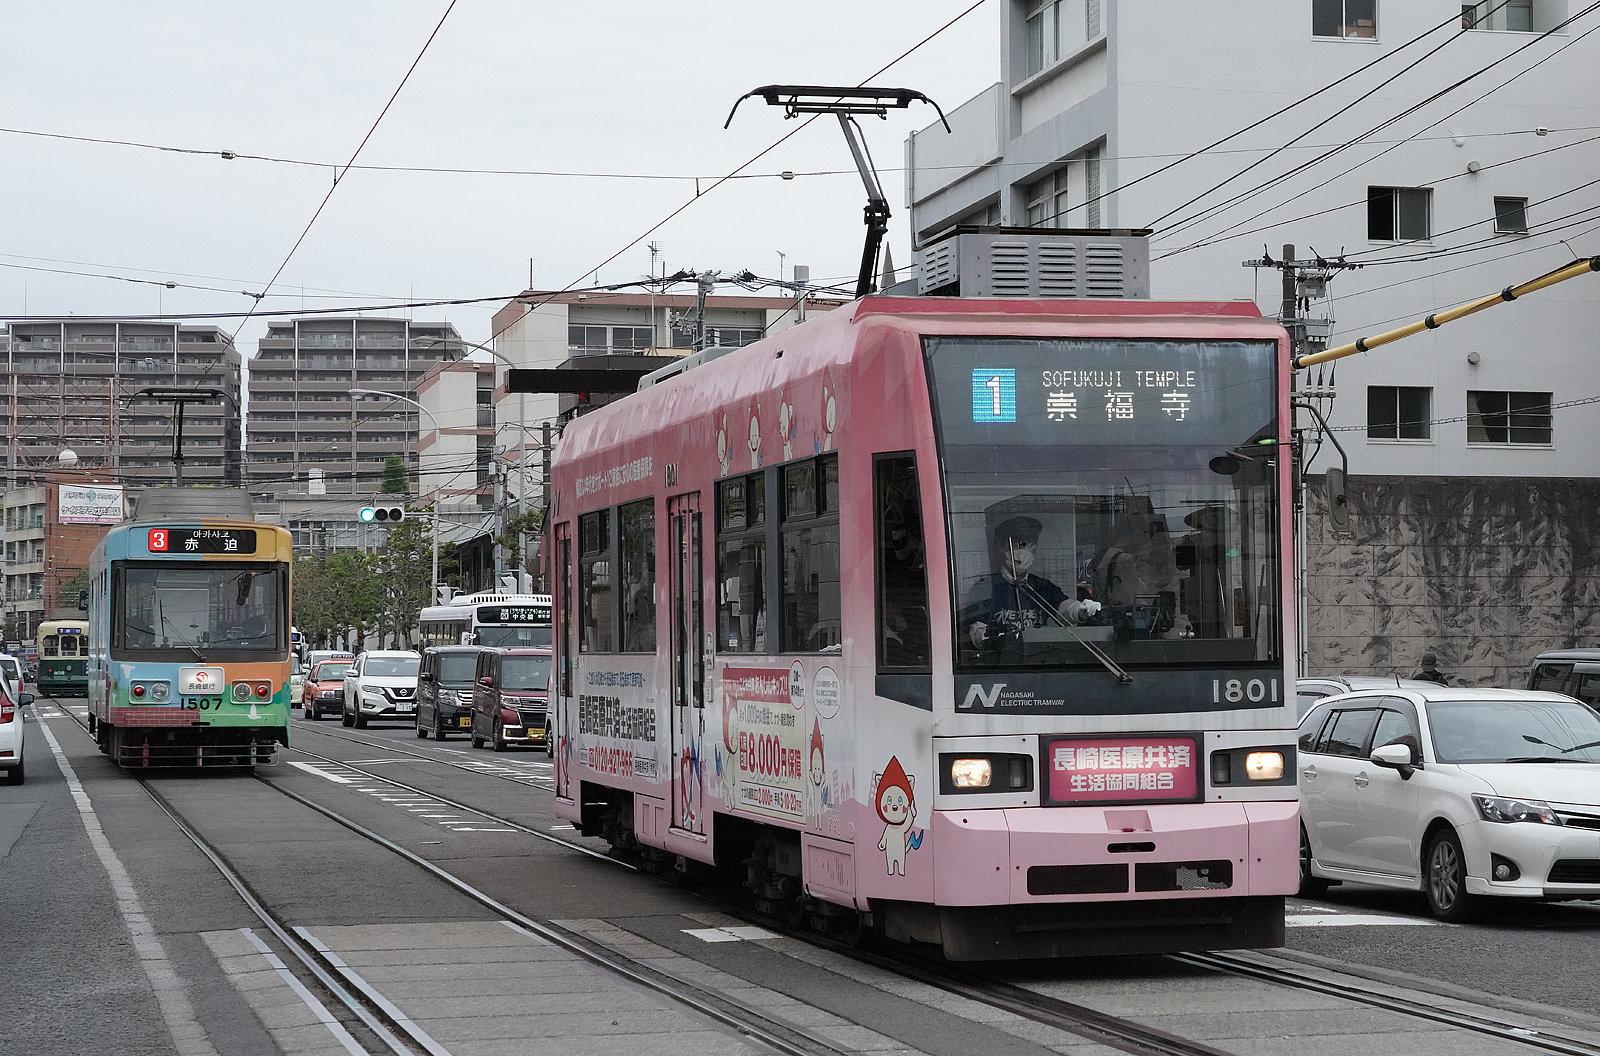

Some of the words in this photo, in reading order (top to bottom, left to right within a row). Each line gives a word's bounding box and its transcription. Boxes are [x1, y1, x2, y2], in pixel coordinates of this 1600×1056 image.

[1042, 371, 1122, 388] SOFUKUJI
[1136, 371, 1196, 388] TEMPLE
[985, 375, 1002, 416] 1
[1047, 390, 1191, 422] 崇福寺
[153, 531, 165, 548] 3
[184, 538, 239, 551] 赤迫
[1000, 691, 1035, 699] NAGASAKI
[1212, 678, 1278, 703] 1801
[180, 698, 223, 711] 1507
[1000, 699, 1033, 707] ELECTRIC
[1034, 699, 1065, 707] TRAMWAY
[1053, 745, 1191, 771] 長崎医療共済
[1070, 772, 1174, 793] 生活協同組合
